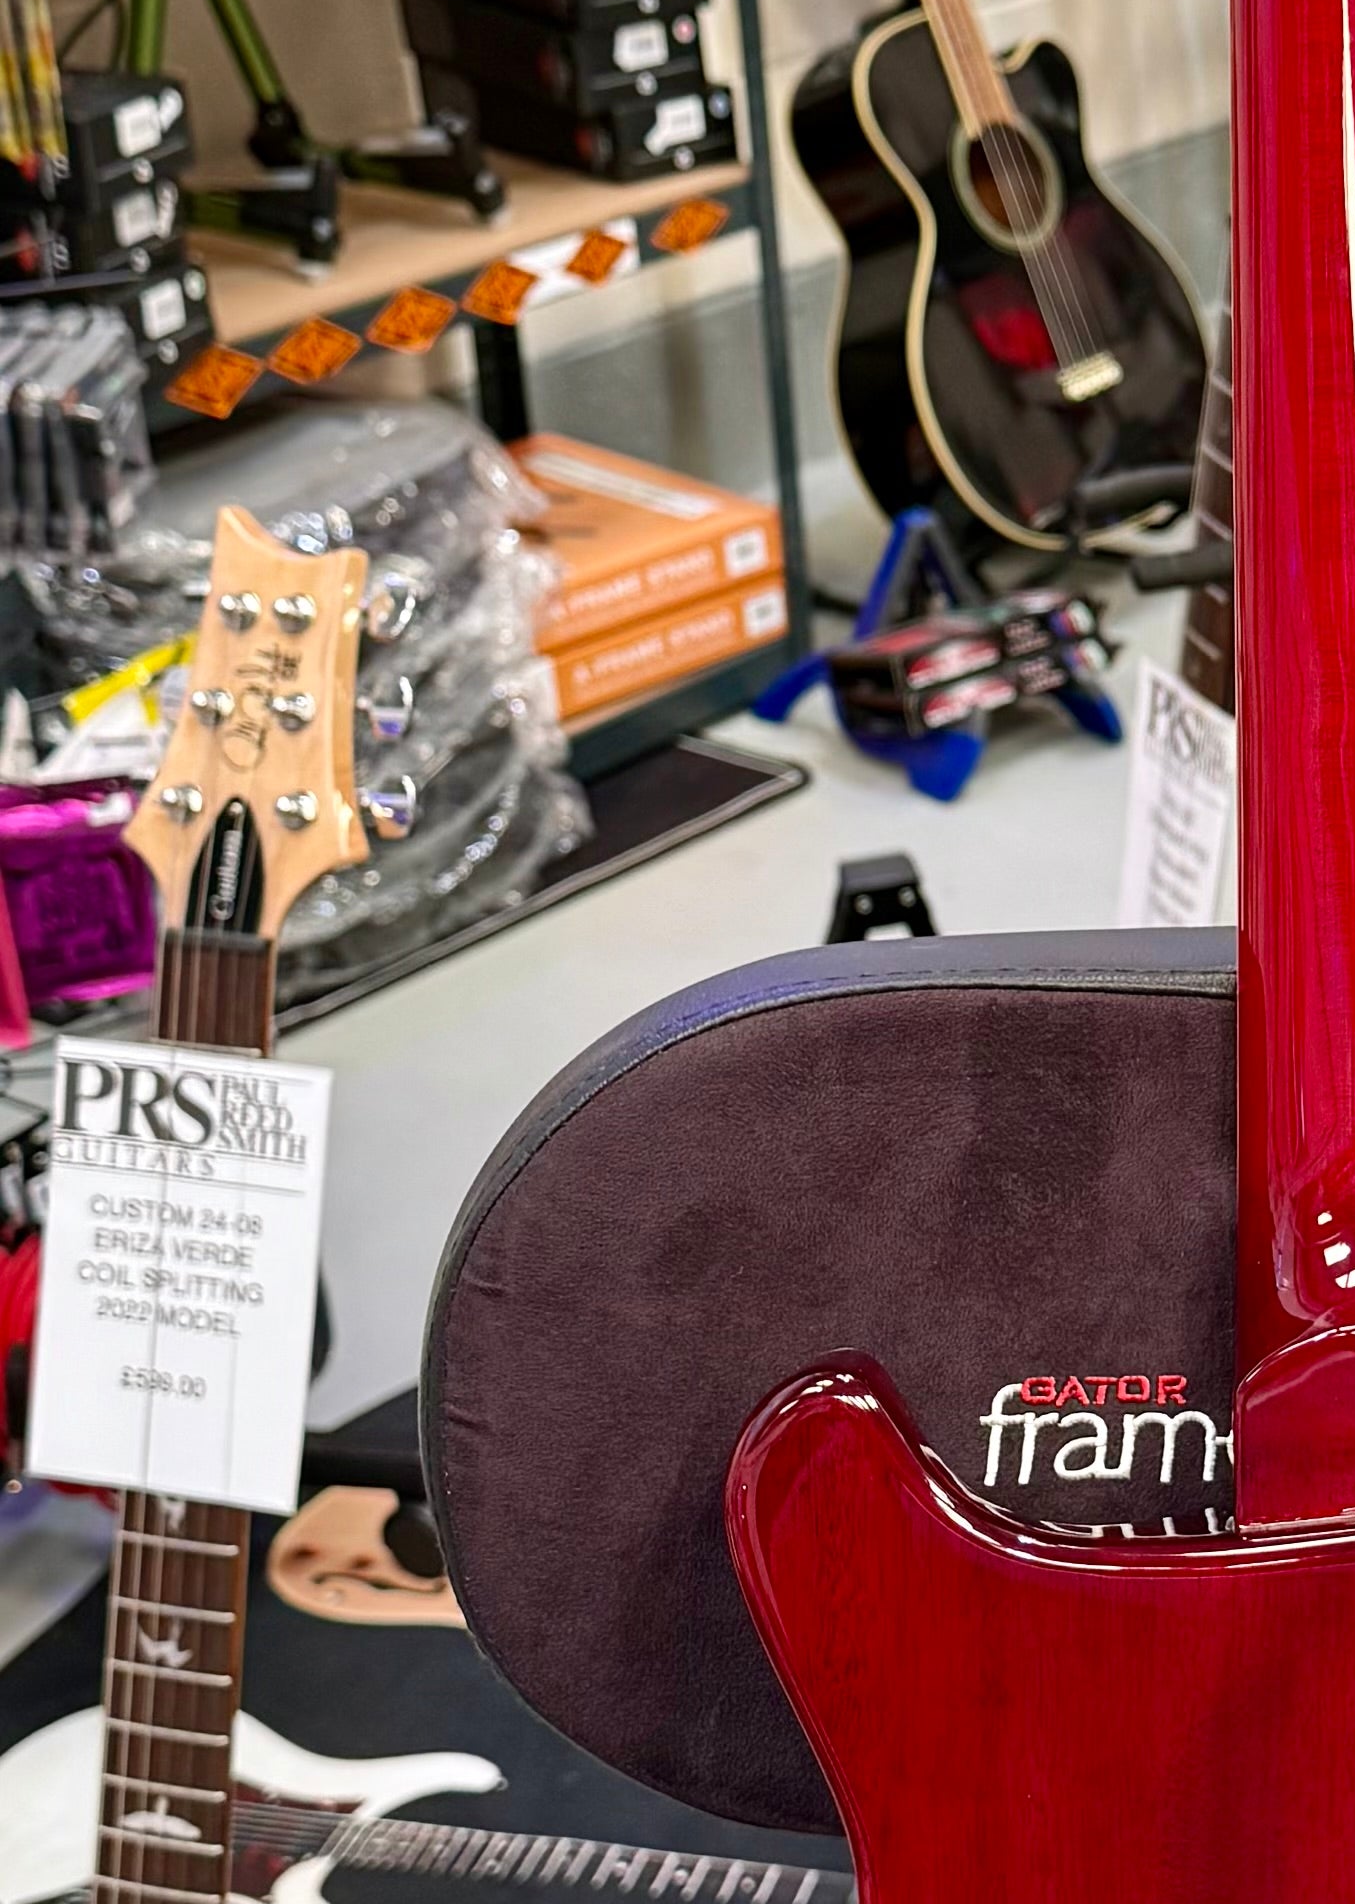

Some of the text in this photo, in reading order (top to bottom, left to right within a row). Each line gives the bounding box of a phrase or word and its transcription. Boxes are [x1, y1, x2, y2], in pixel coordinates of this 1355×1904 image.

[58, 1057, 216, 1144] PRS
[221, 1074, 281, 1107] PAUL
[53, 1136, 217, 1176] GUITARS
[217, 1124, 306, 1161] SMITH
[89, 1193, 195, 1228] CUSTOM
[172, 1236, 255, 1269] VERDE
[77, 1259, 265, 1306] COIL SPLITTING
[156, 1302, 241, 1336] MODEL
[1020, 1375, 1187, 1405] GATOR
